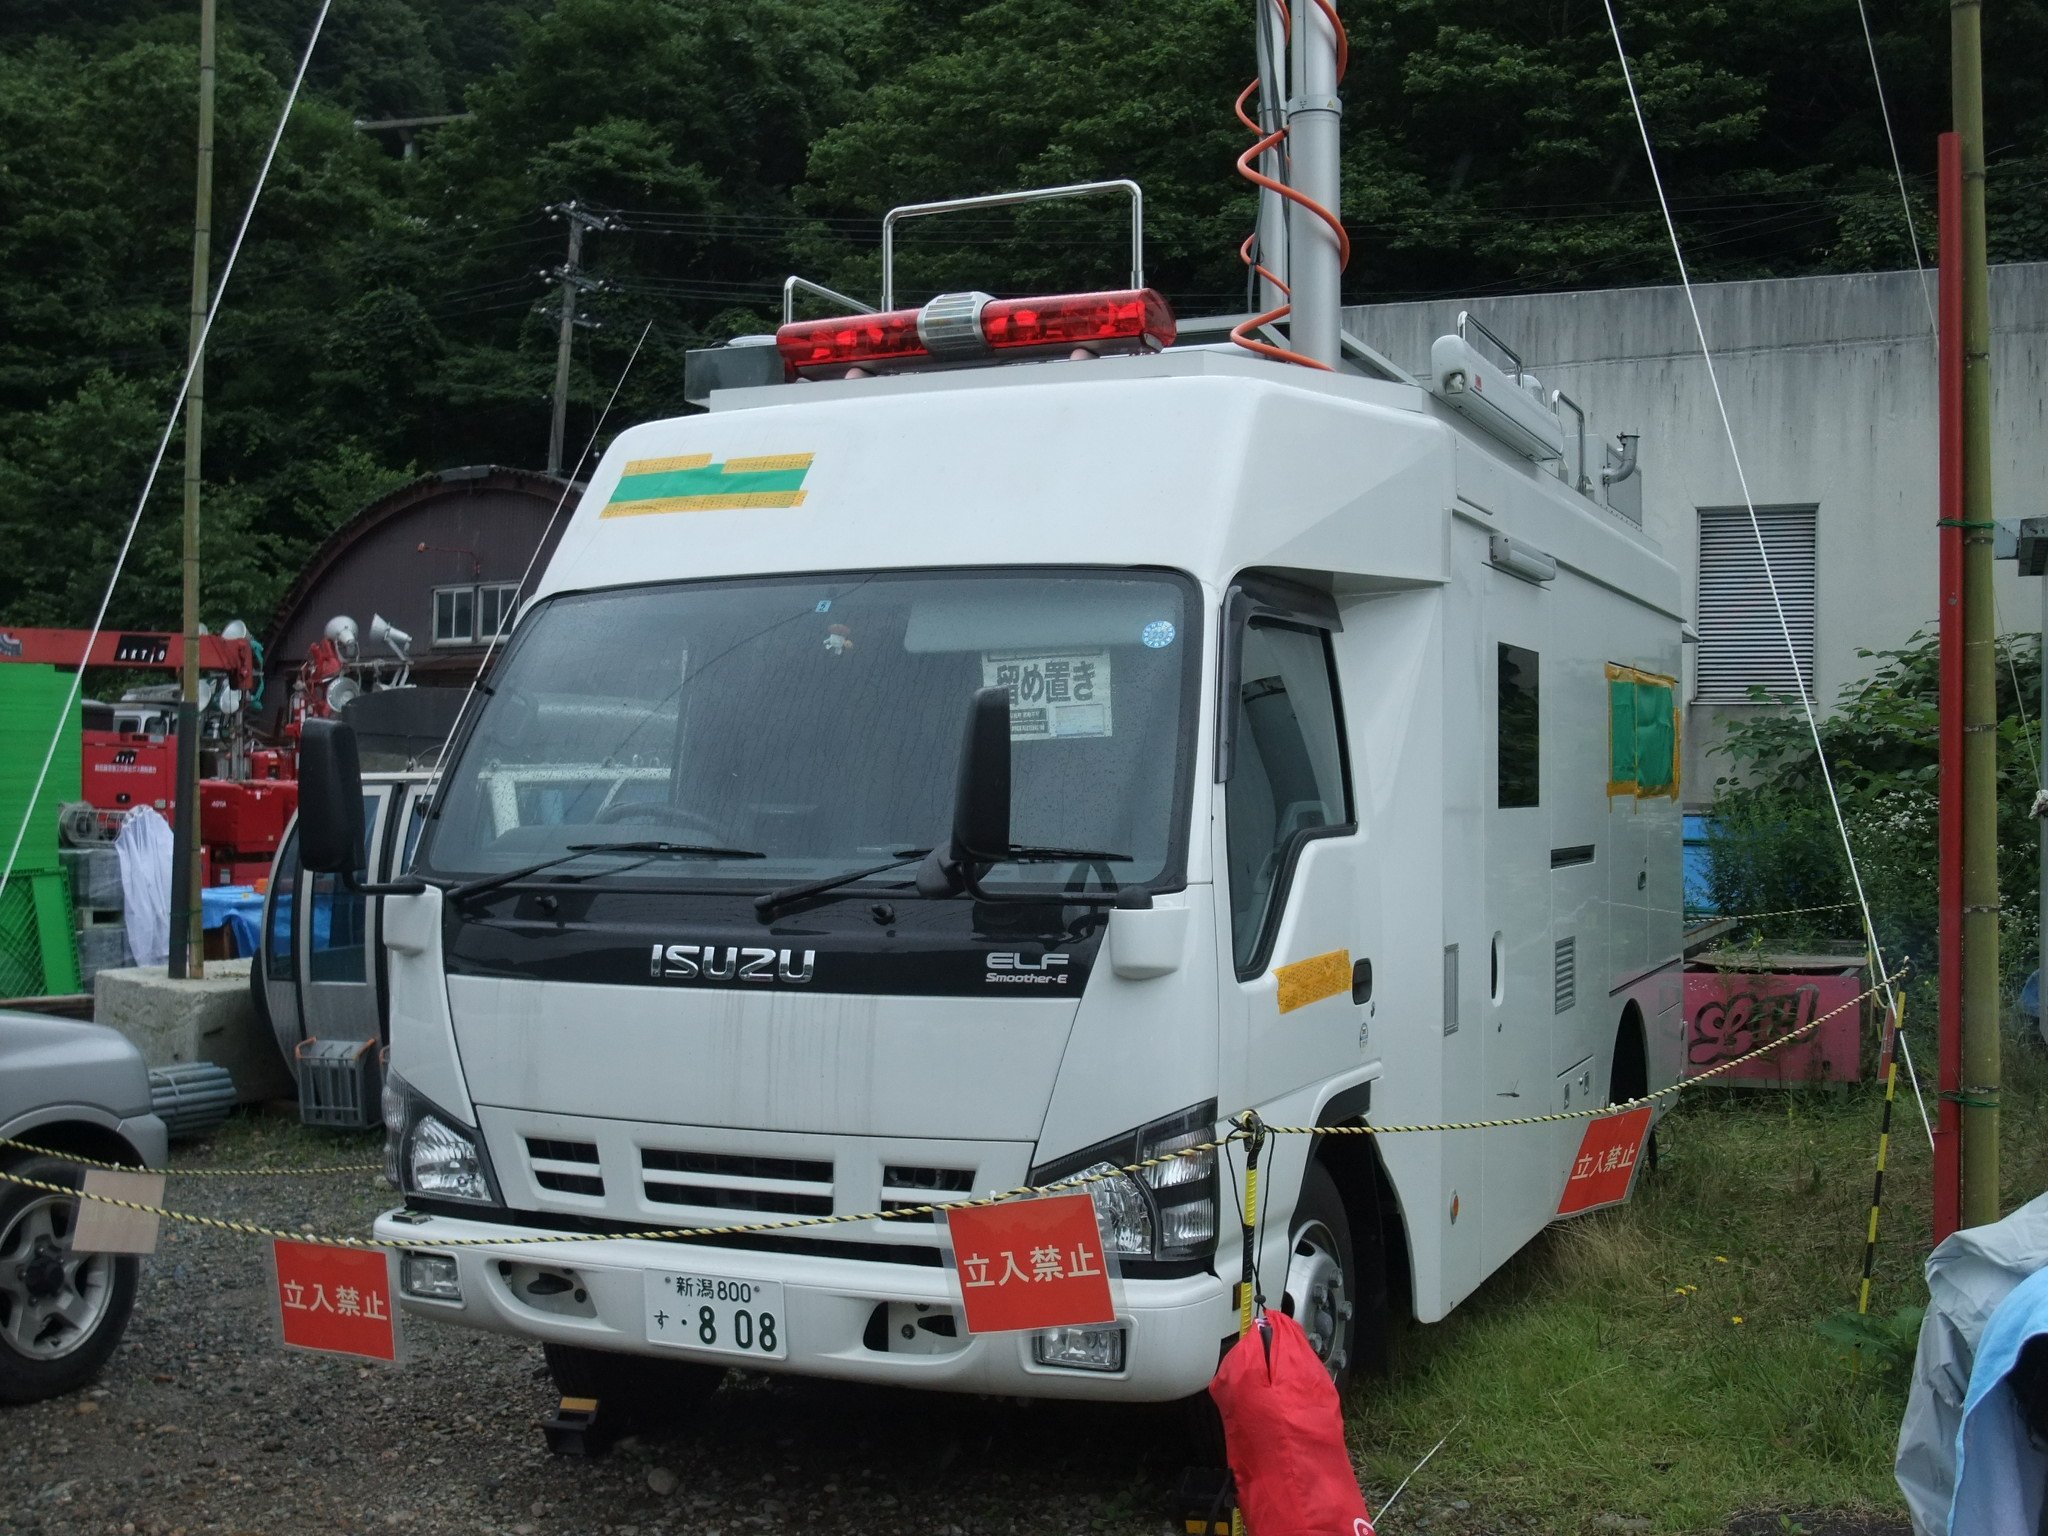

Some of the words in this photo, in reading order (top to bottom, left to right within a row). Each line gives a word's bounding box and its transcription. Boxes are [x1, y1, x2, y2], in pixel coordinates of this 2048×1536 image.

[997, 661, 1096, 705] 留め置き
[650, 944, 816, 984] ISUZU
[985, 972, 1069, 984] Smoother-E
[986, 952, 1070, 970] ELF
[1571, 1142, 1636, 1180] 立入禁止
[963, 1242, 1101, 1288] 立入禁止
[283, 1279, 388, 1320] 立入禁止
